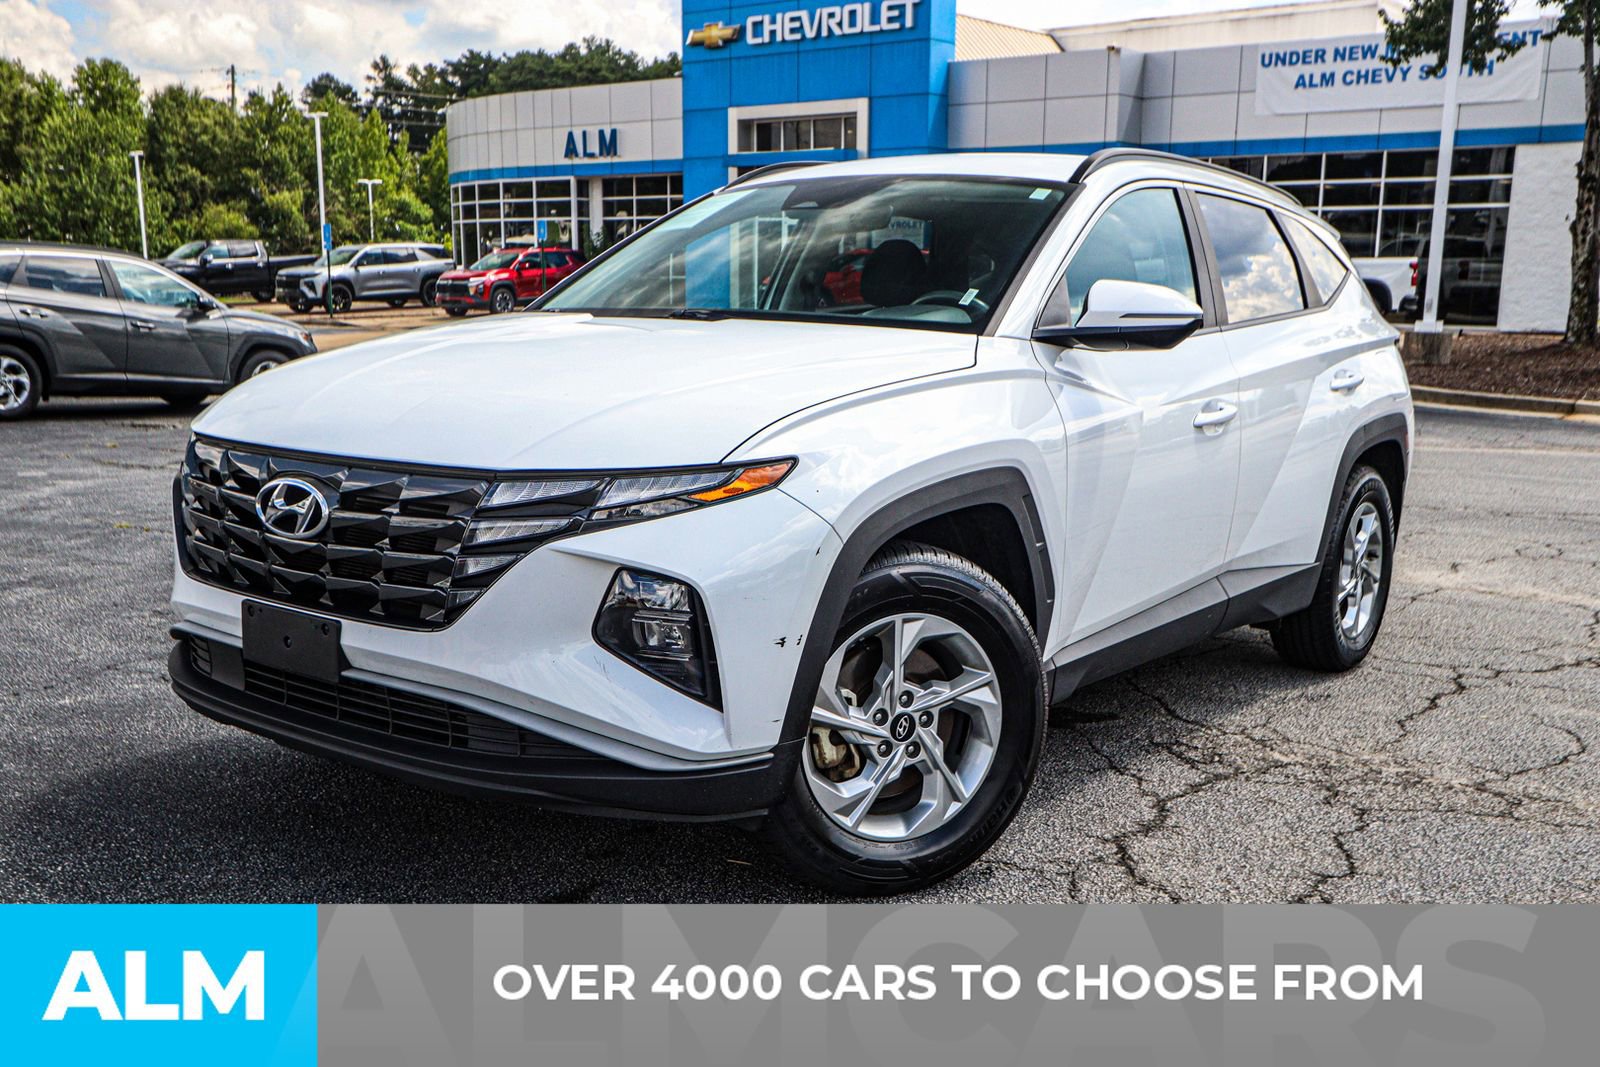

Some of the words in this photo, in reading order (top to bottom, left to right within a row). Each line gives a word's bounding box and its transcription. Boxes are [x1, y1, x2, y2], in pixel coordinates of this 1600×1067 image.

[745, 0, 921, 45] CHEVROLET
[1260, 48, 1327, 68] UNDER
[1333, 43, 1379, 62] NEW
[1294, 70, 1336, 89] ALM
[1342, 65, 1412, 86] CHEVY
[563, 128, 619, 158] ALM
